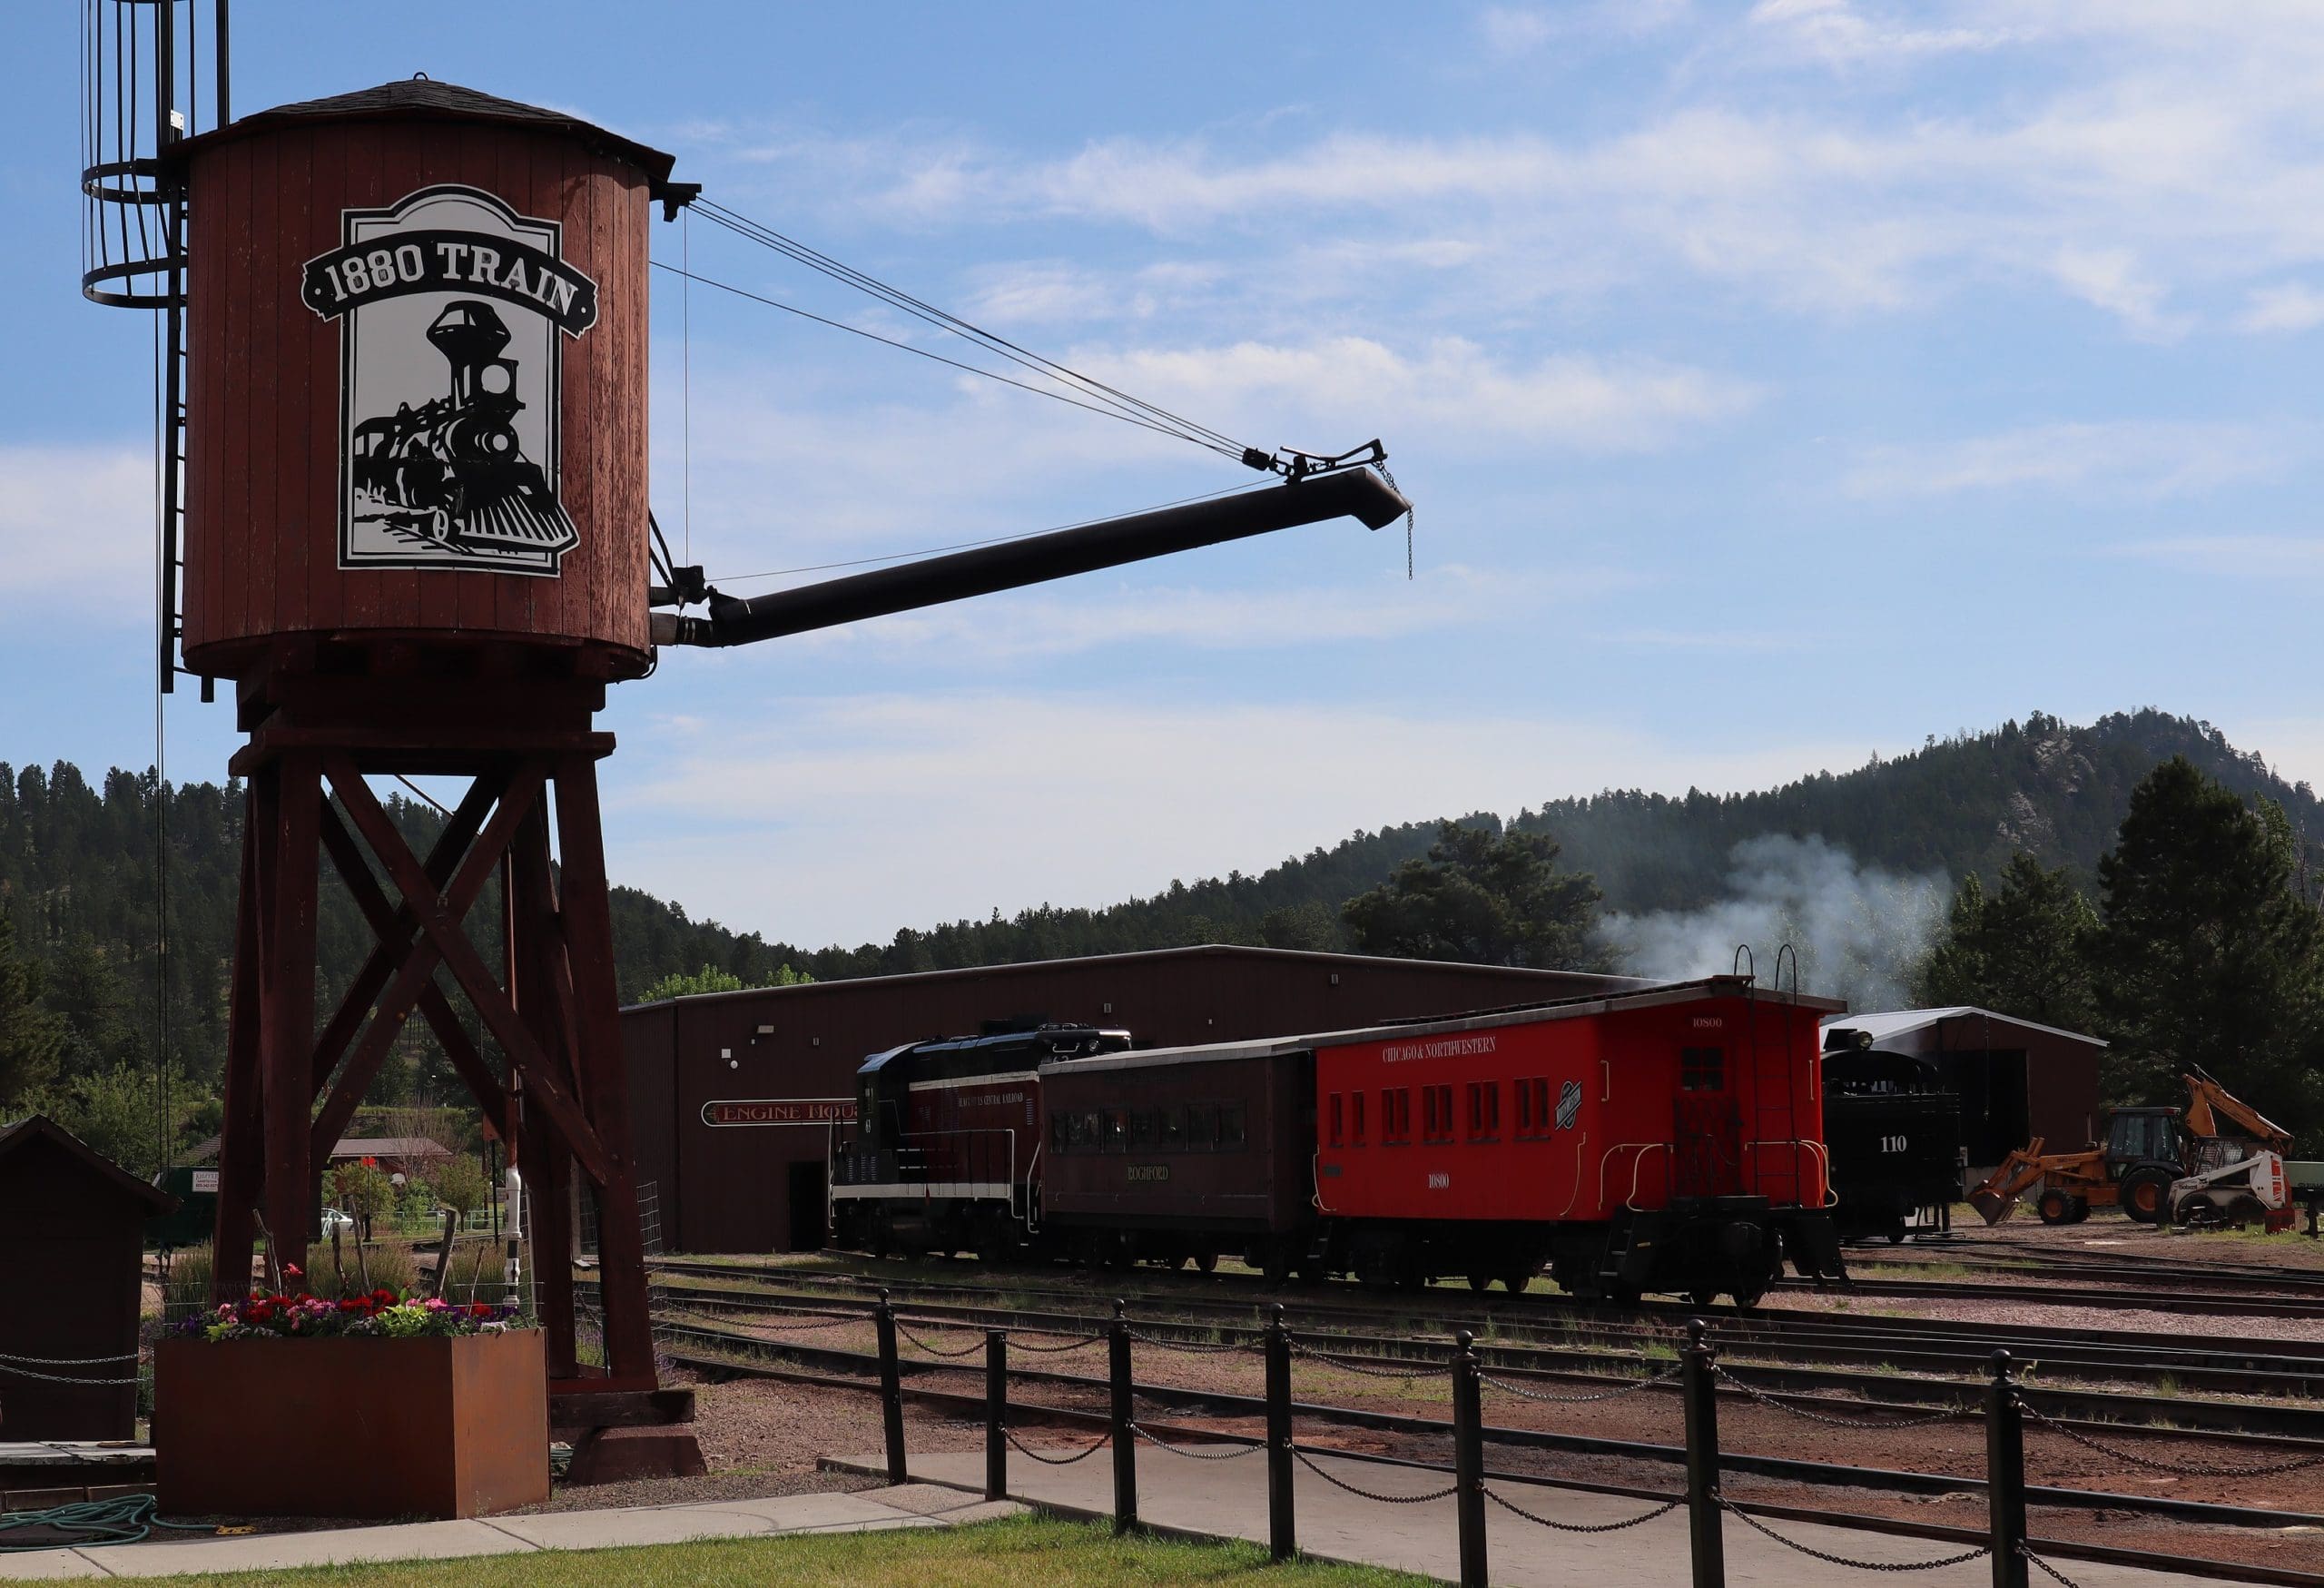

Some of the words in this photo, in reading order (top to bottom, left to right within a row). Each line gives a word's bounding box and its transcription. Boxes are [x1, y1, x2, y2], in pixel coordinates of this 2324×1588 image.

[325, 243, 425, 302] 1880
[437, 242, 579, 316] TRAIN
[1693, 1017, 1722, 1028] 10800
[1382, 1045, 1416, 1063] CHICAGO
[1417, 1044, 1423, 1060] &
[723, 1106, 802, 1121] ENGINE
[1880, 1135, 1907, 1153] 110
[1428, 1173, 1450, 1189] 10800
